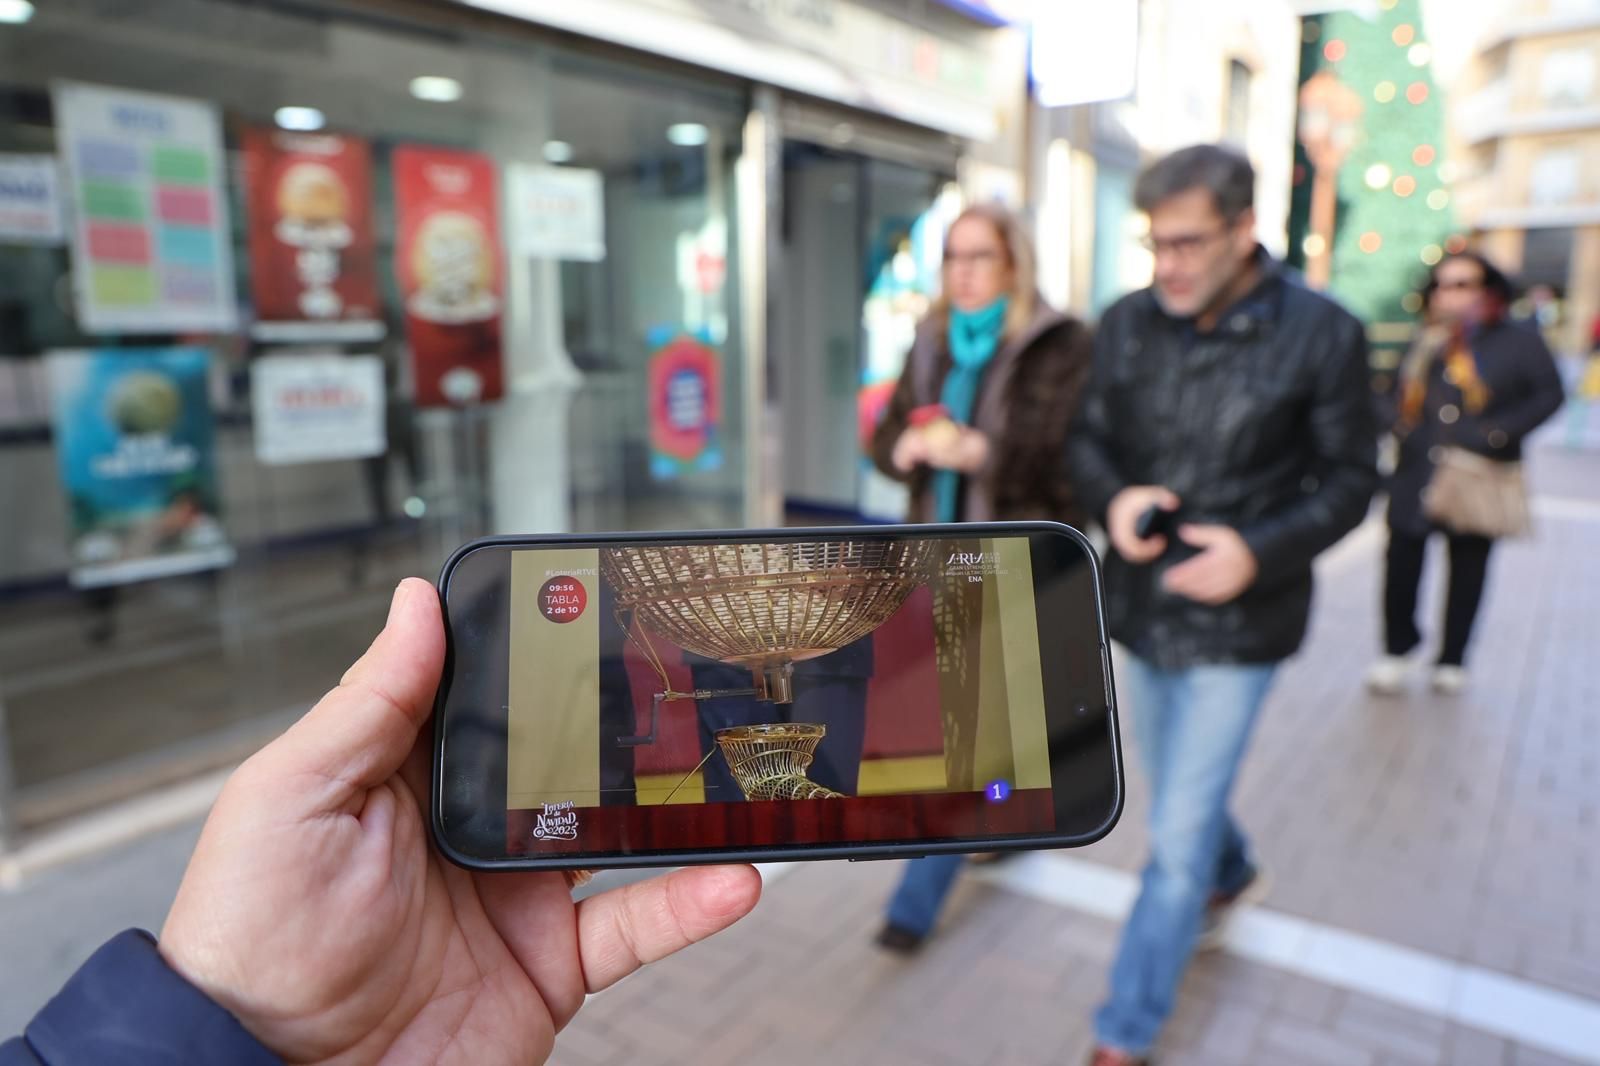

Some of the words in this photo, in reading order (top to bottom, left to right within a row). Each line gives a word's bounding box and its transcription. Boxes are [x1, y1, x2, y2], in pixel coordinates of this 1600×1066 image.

[545, 595, 579, 604] TABLA
[993, 784, 1002, 799] 1
[552, 826, 577, 835] 2025
